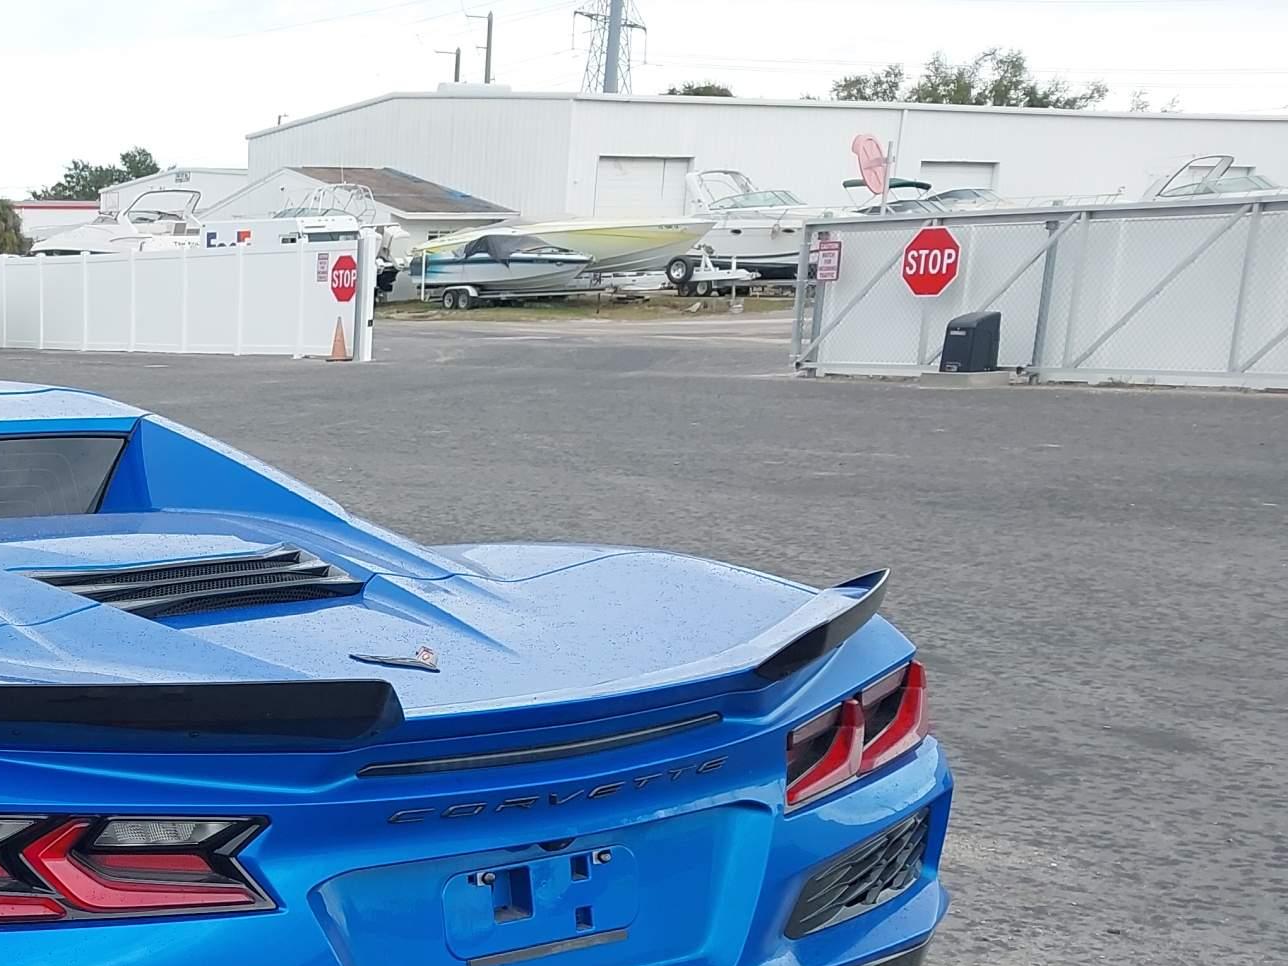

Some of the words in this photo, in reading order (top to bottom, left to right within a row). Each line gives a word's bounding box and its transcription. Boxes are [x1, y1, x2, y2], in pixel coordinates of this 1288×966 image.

[906, 249, 955, 274] STOP
[332, 269, 357, 289] STOP
[387, 756, 729, 824] CORVETTE
